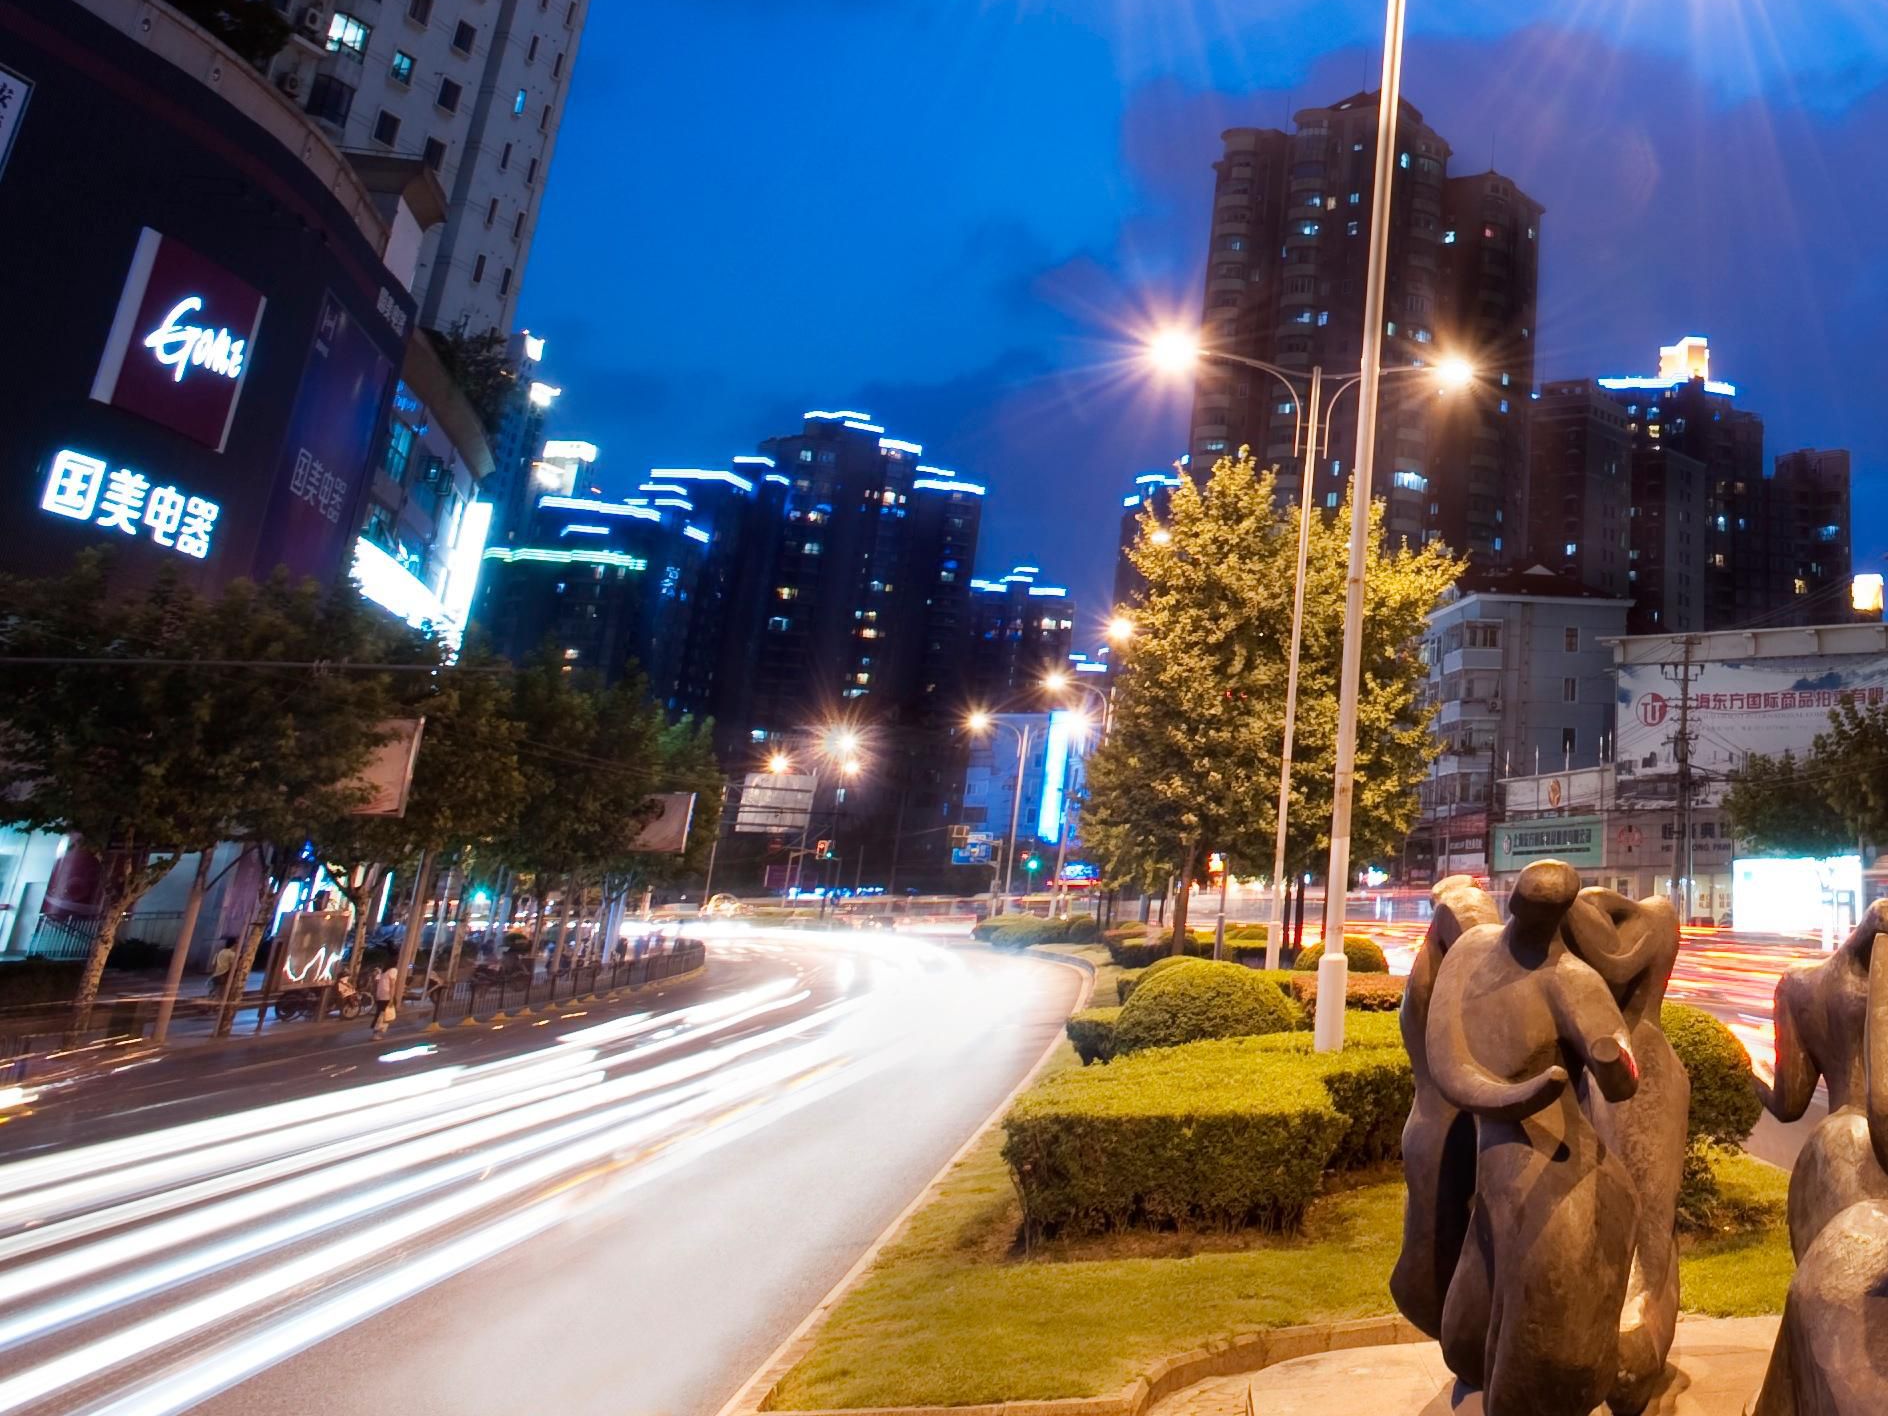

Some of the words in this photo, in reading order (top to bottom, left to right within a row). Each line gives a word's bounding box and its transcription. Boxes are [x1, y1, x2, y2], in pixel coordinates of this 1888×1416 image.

[42, 449, 220, 559] 国美电器
[290, 447, 348, 524] 国美电器
